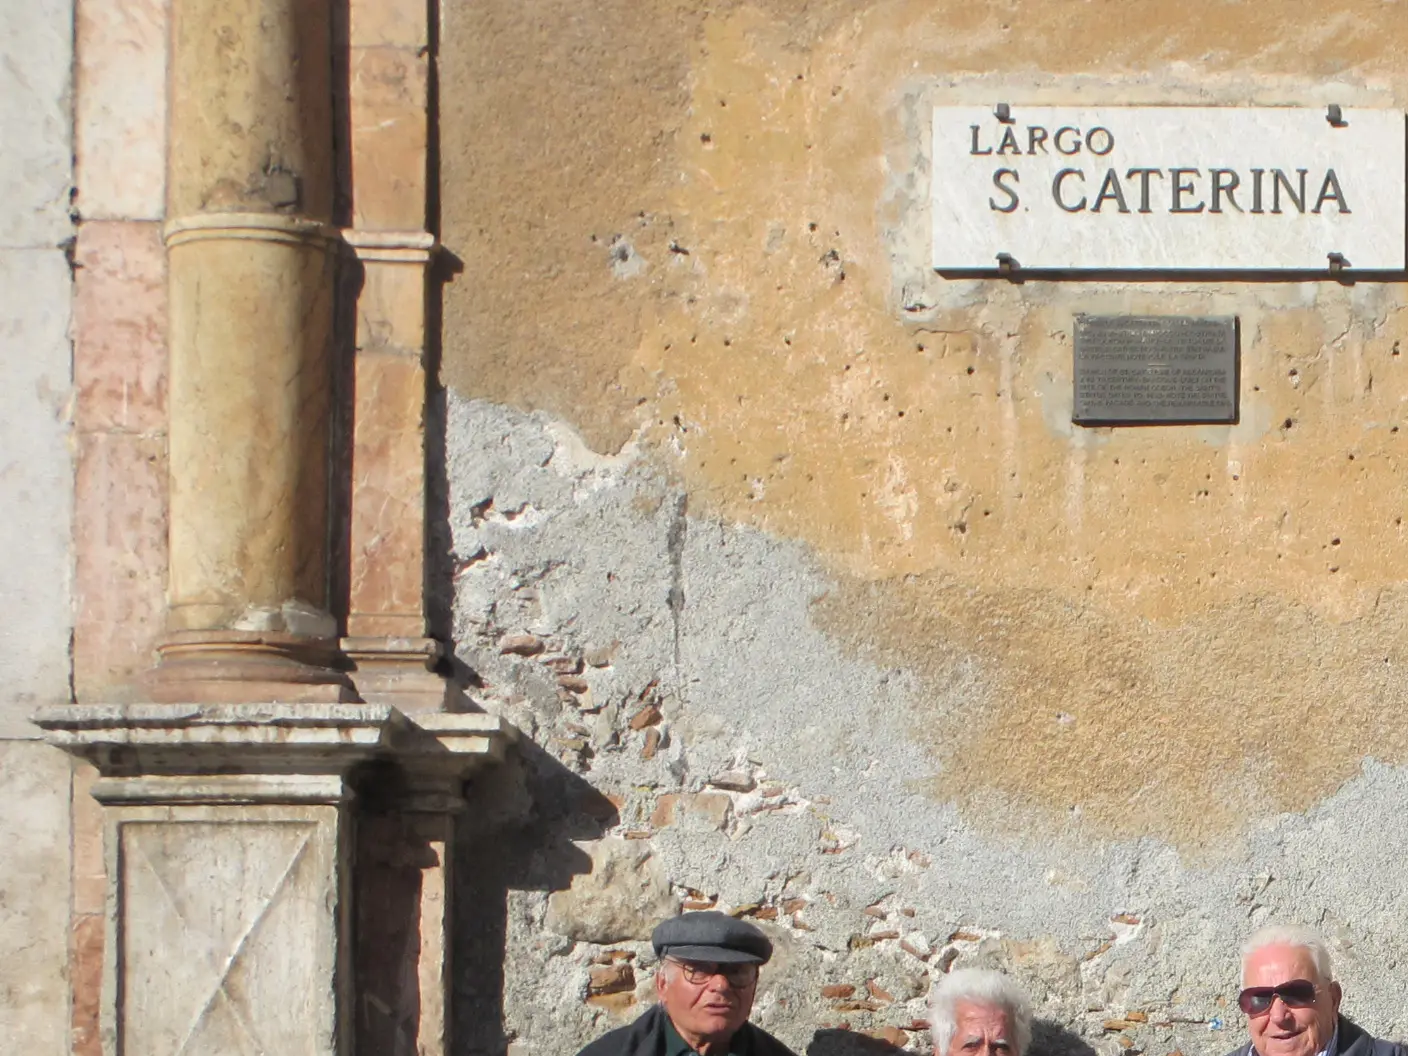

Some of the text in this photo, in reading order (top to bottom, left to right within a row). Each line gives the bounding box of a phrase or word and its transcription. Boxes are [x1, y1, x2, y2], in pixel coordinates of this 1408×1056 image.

[969, 125, 1115, 155] LARGO
[989, 168, 1352, 213] S. CATERINA
